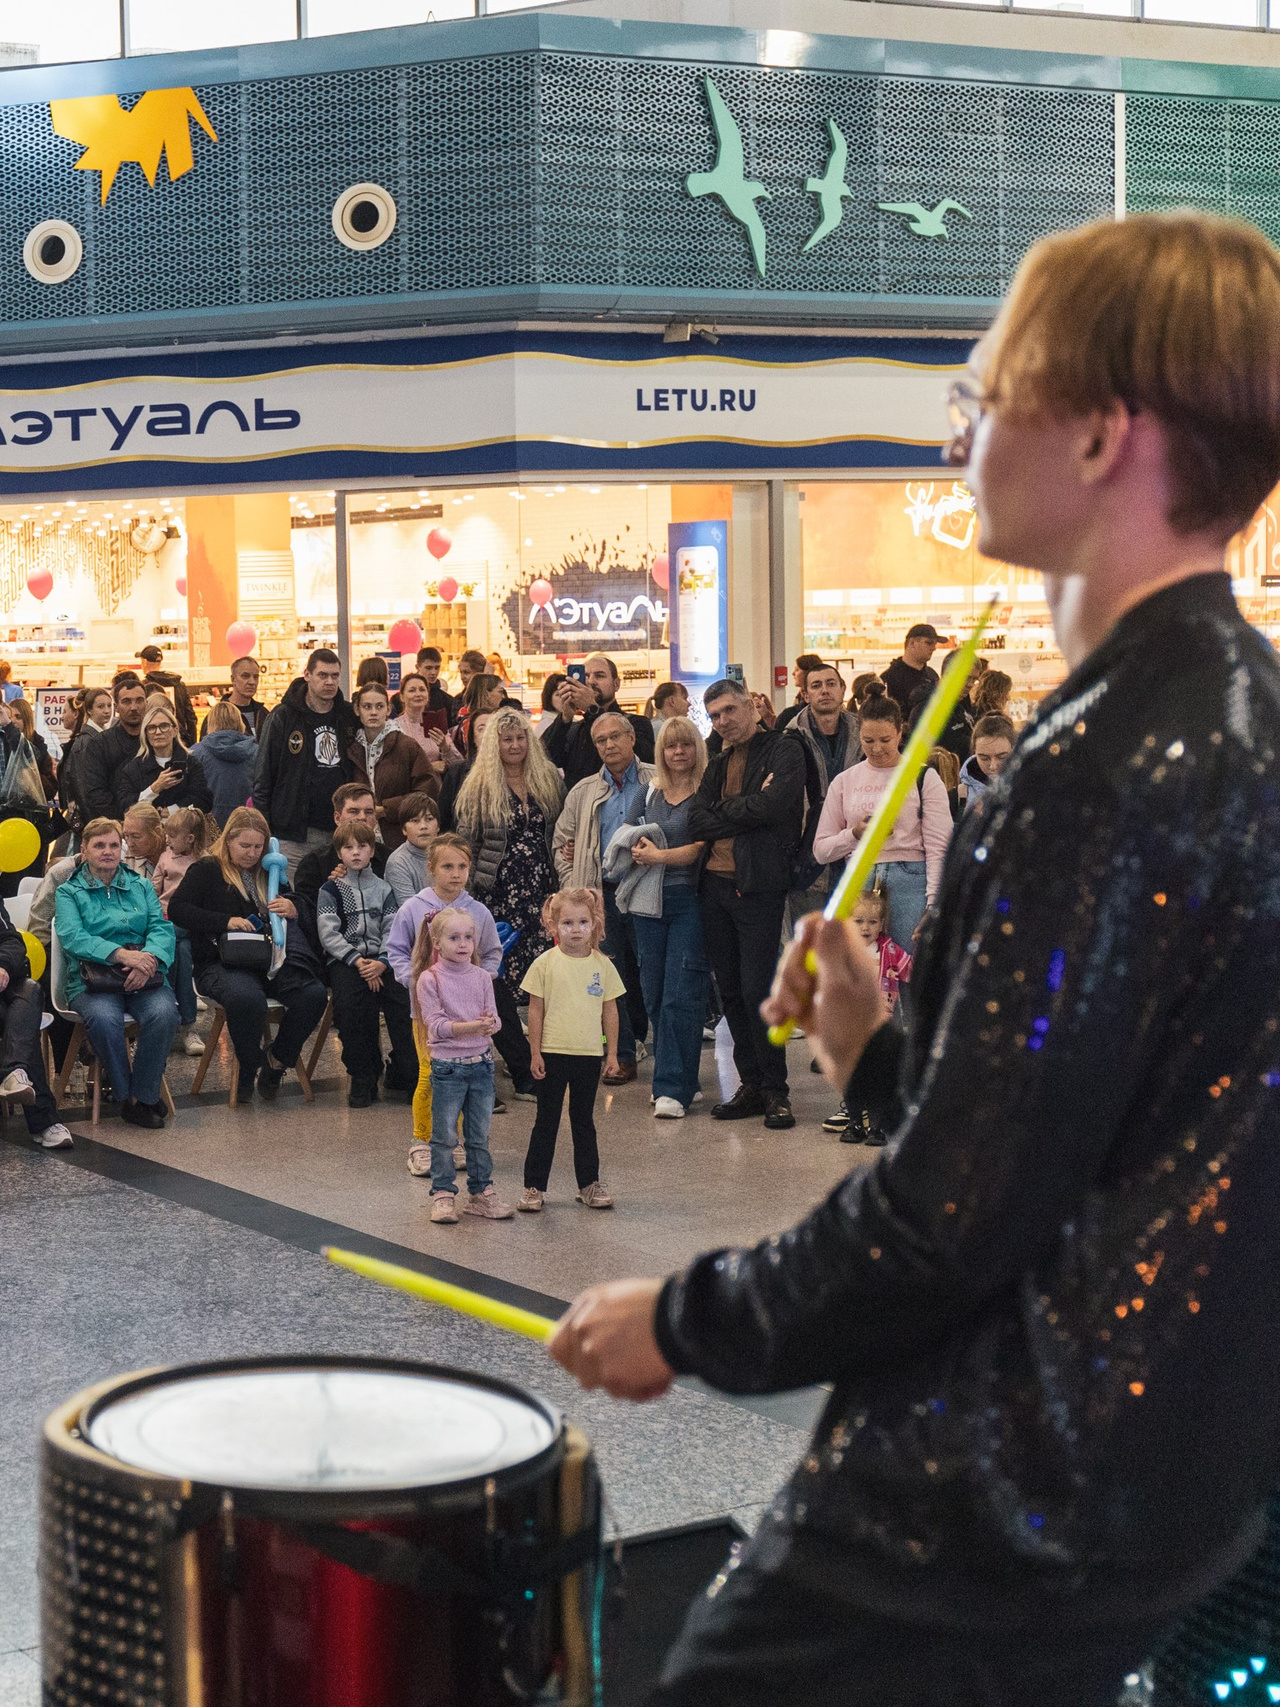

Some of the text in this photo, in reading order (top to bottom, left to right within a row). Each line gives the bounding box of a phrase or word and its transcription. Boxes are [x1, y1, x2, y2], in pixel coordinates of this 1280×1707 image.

[636, 388, 756, 412] LETU.RU
[44, 695, 66, 704] РАБ
[44, 706, 51, 715] В
